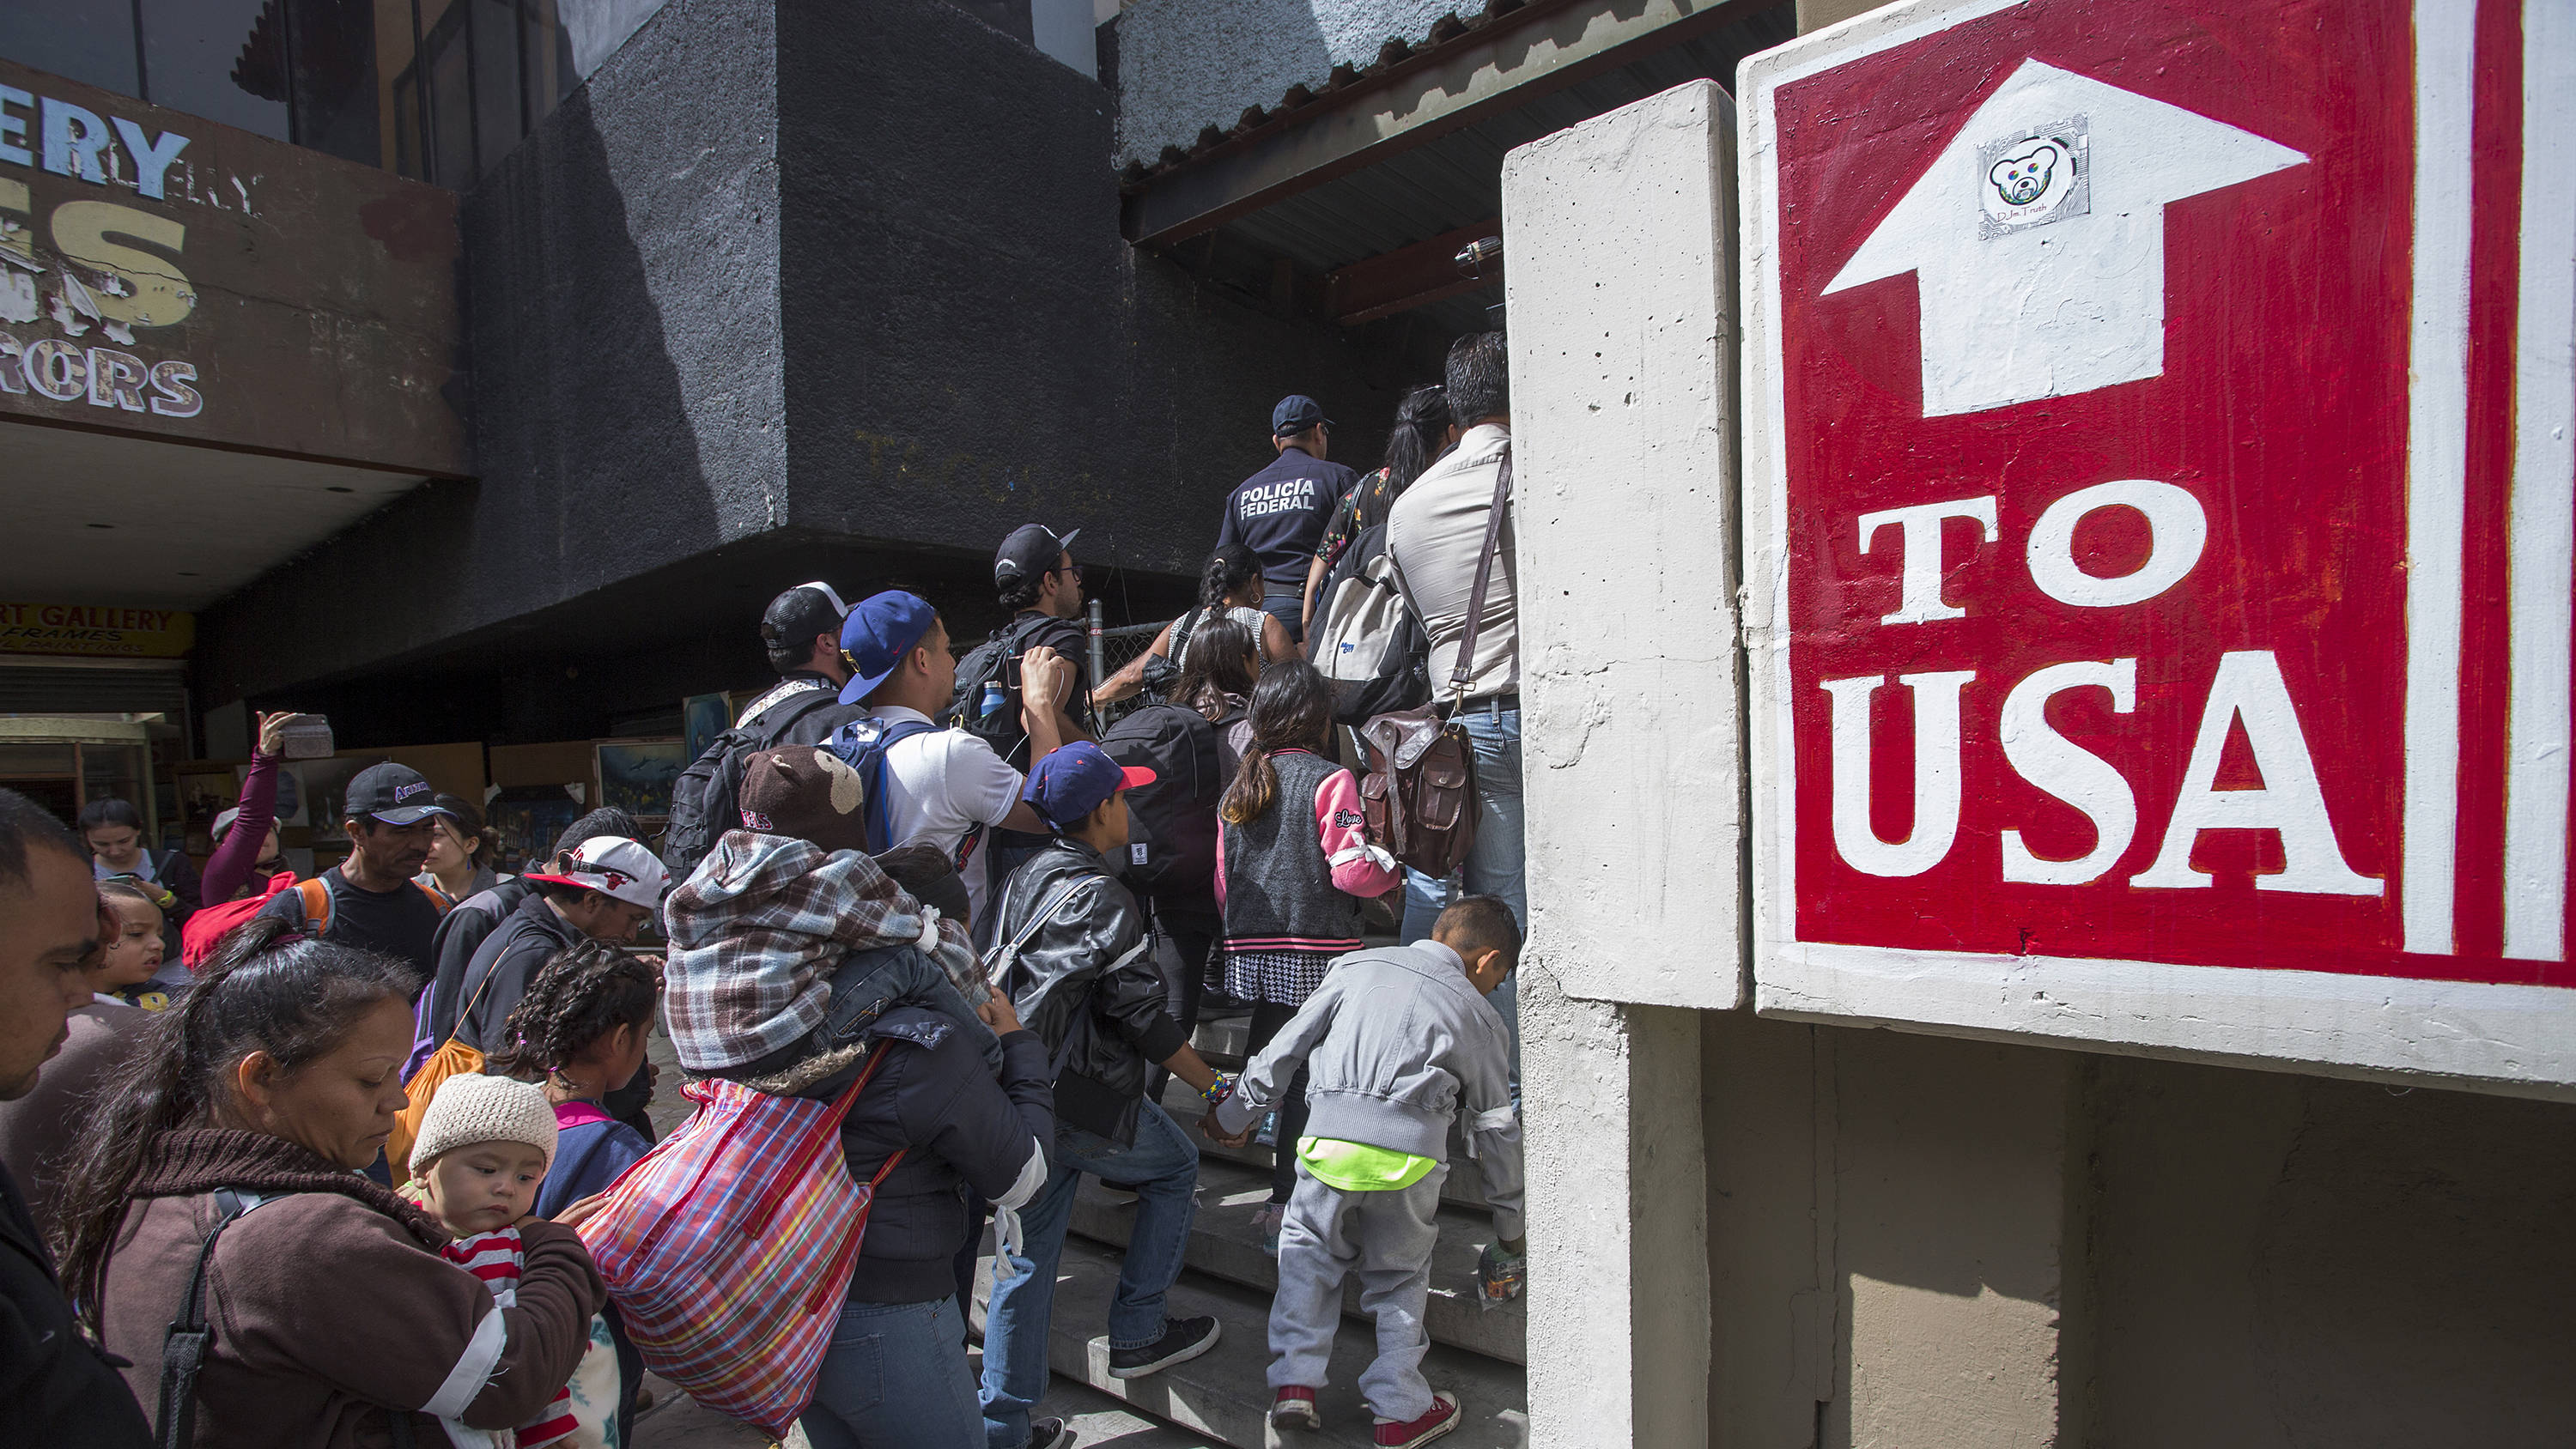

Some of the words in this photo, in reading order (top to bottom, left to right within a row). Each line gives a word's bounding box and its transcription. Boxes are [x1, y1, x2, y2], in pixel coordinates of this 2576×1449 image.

[1241, 478, 1315, 506] POLICÍA
[1240, 495, 1315, 520] FEDERAL
[1858, 479, 2207, 626] TO
[40, 606, 172, 632] GALLERY
[2, 627, 124, 641] FRAMES
[25, 640, 144, 652] PAINTINGS
[1819, 650, 2385, 896] USA
[1334, 809, 1363, 828] Love
